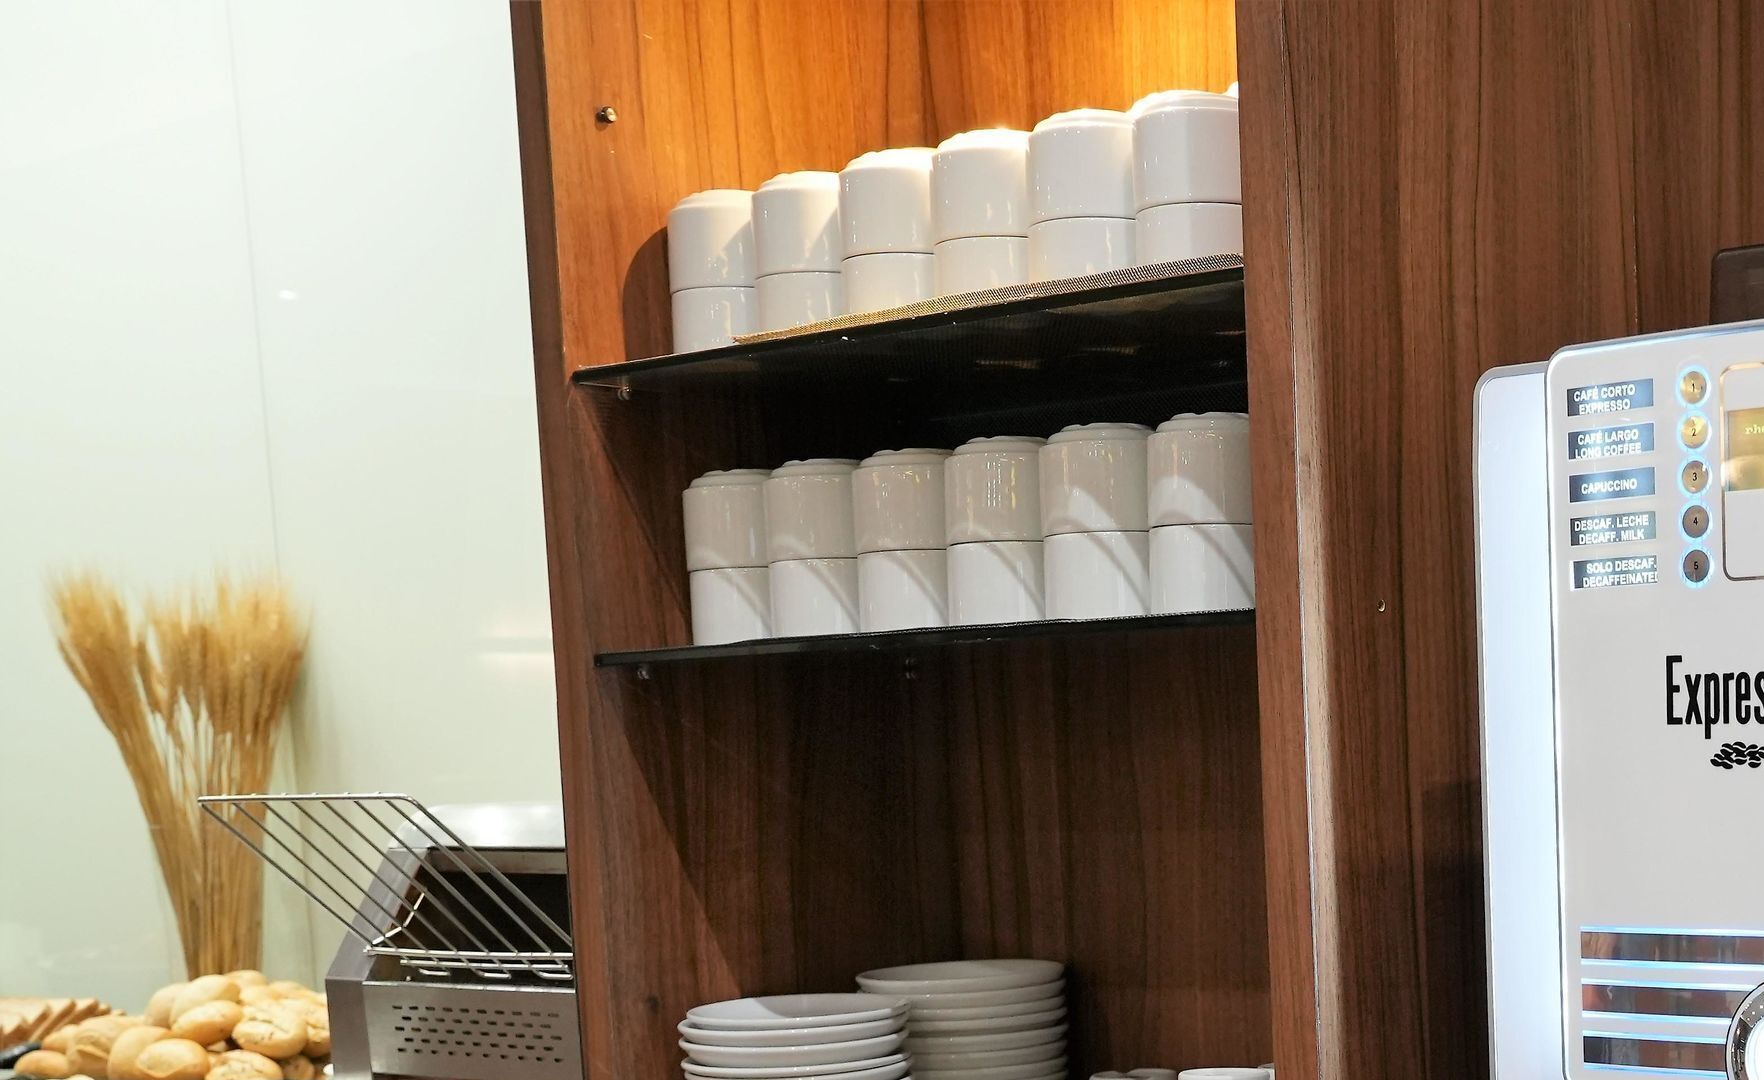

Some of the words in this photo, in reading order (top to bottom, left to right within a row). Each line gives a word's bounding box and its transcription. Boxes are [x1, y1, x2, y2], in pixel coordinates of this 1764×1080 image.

[1573, 385, 1599, 402] CAFÉ
[1601, 383, 1637, 399] CORTO
[1579, 398, 1631, 415] EXPRESSO
[1577, 430, 1603, 445] CAFÉ
[1604, 428, 1639, 442] LARGO
[1691, 427, 1697, 437] 2
[1575, 446, 1601, 459] LONG
[1603, 441, 1642, 456] COFFEE
[1692, 472, 1698, 481] 3
[1581, 478, 1638, 495] CAPUCCINO
[1574, 518, 1615, 532] DESCAF.
[1617, 514, 1649, 528] LECHE
[1693, 516, 1699, 526] 4
[1579, 532, 1619, 545] DECAFF.
[1621, 528, 1645, 542] MILK
[1586, 561, 1613, 574] SOLO
[1615, 557, 1657, 571] DESCAF.
[1693, 561, 1699, 570] 5
